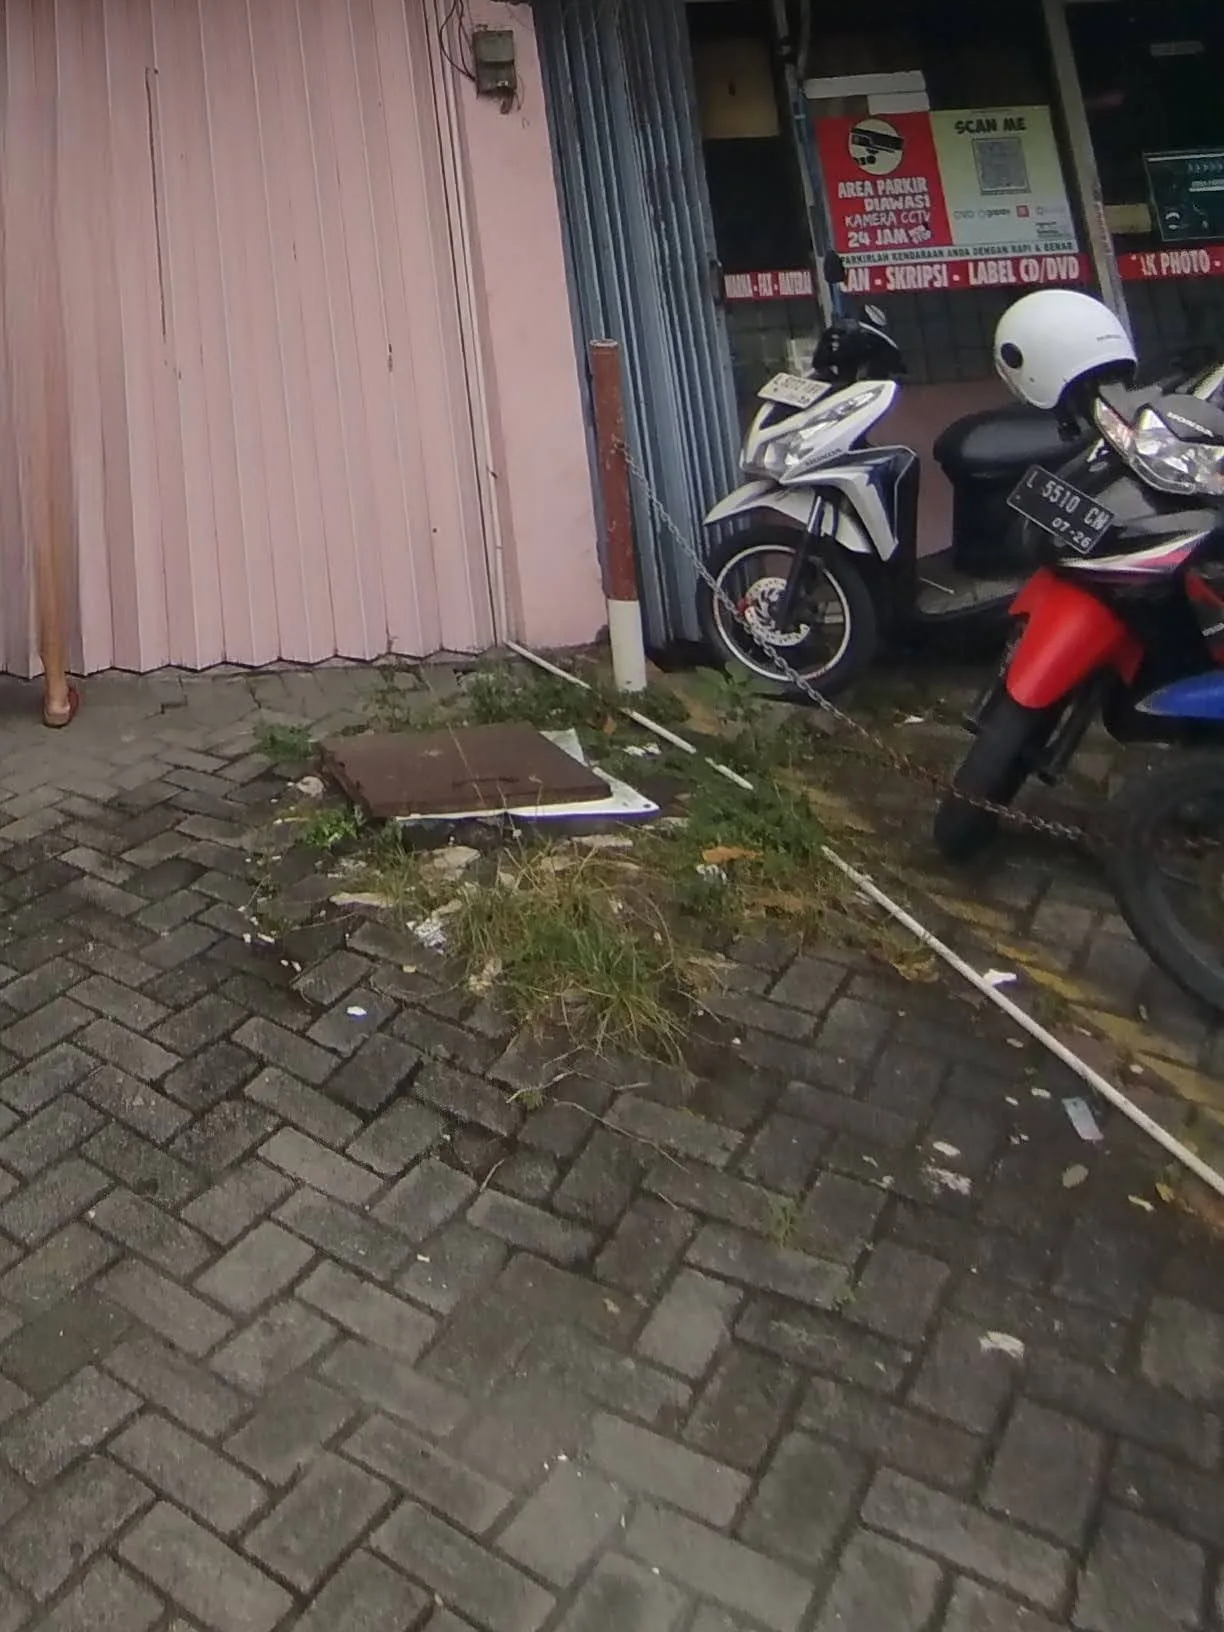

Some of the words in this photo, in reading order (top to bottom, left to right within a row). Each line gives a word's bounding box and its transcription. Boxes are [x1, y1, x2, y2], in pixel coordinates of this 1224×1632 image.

[954, 118, 998, 135] SCAN
[1003, 117, 1027, 132] ME
[838, 180, 873, 198] AREA
[876, 177, 928, 196] PARKIR
[863, 195, 931, 212] DIAWASI
[844, 212, 897, 228] KAMERA
[901, 210, 931, 225] CCTV
[847, 231, 870, 248] 24
[875, 228, 909, 246] JAM
[892, 251, 944, 262] KENDARAAN
[947, 248, 970, 258] ANDA
[973, 245, 1009, 257] DENGAN
[1160, 249, 1211, 276] PHOTO
[886, 264, 948, 291] SKRIPSI
[969, 259, 1016, 286] LABEL
[1019, 255, 1080, 283] CD/DVD
[1026, 471, 1038, 488] L
[1041, 480, 1081, 513] 5510
